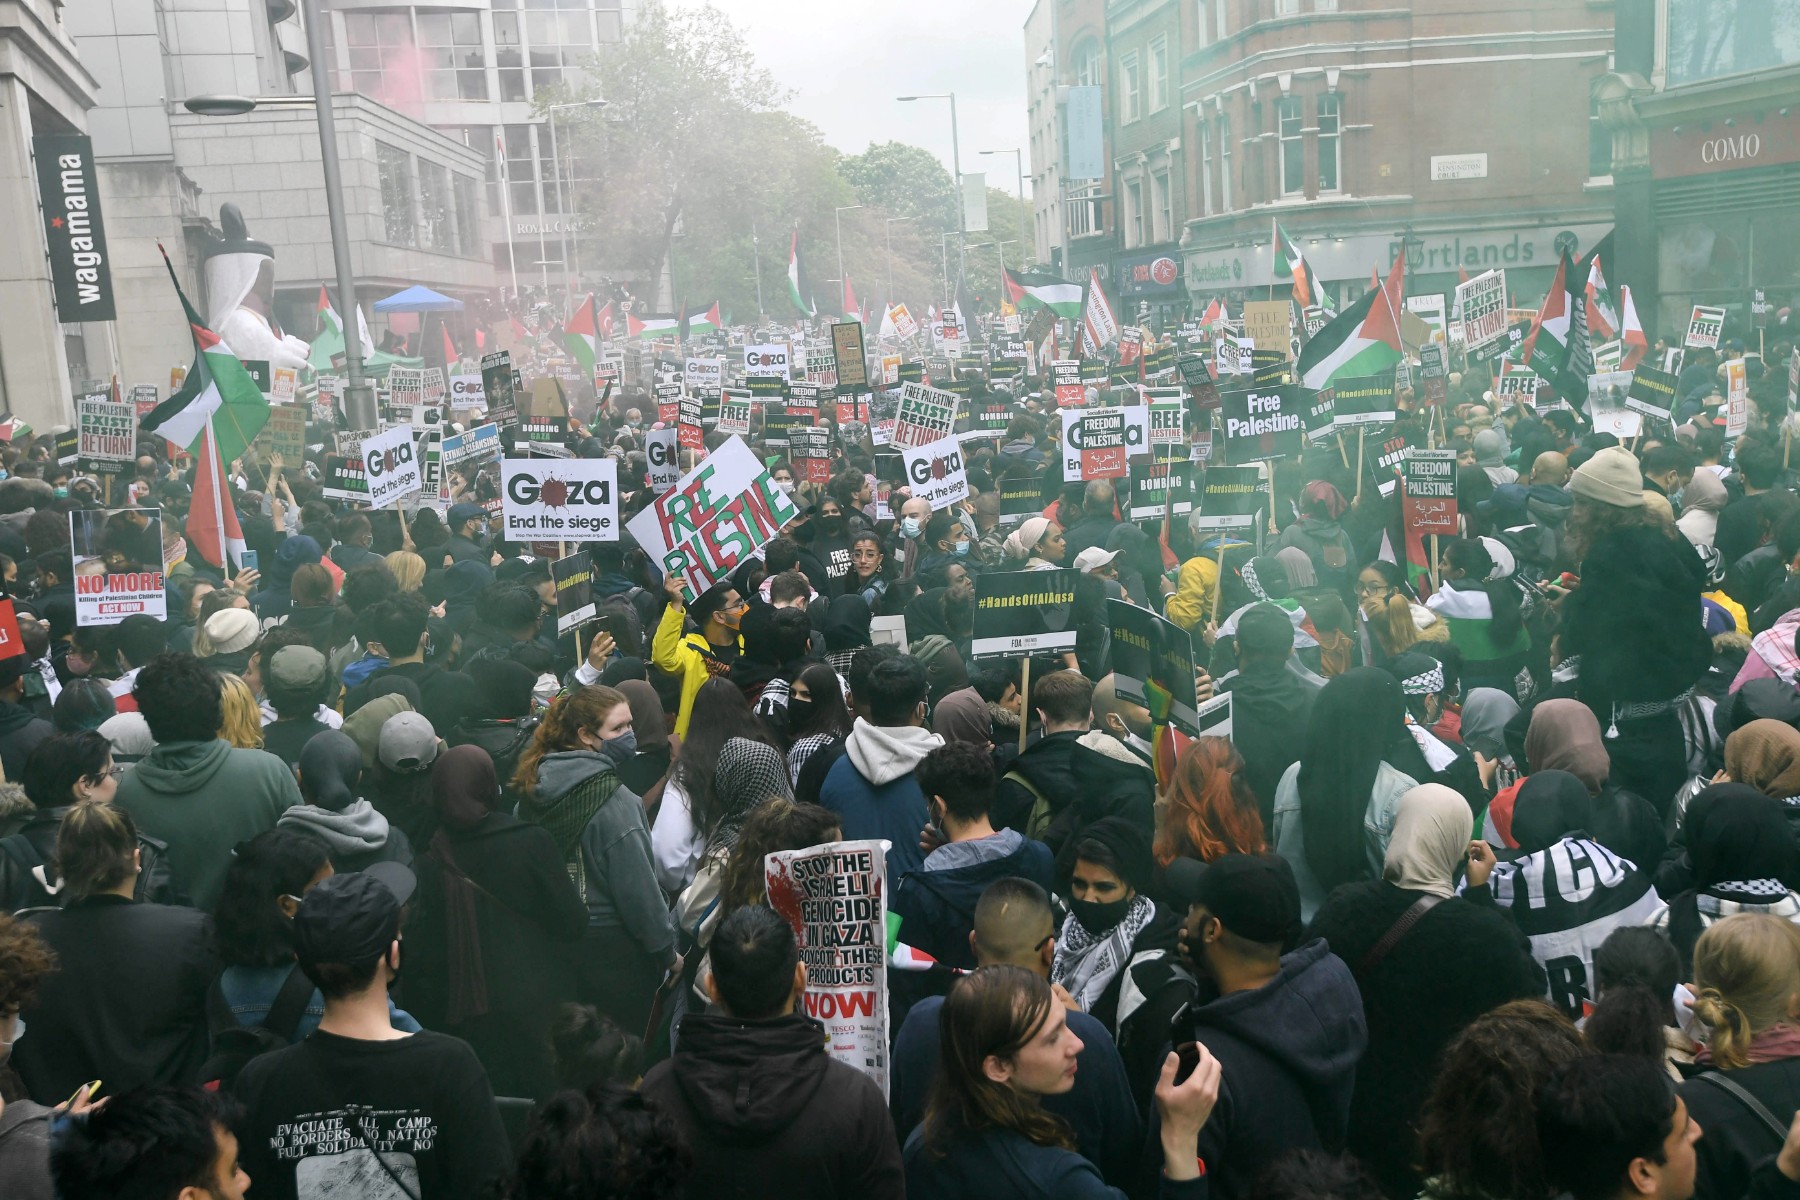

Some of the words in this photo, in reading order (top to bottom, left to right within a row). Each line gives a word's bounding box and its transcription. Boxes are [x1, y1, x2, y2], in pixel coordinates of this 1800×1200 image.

[1702, 134, 1760, 163] COMO
[1438, 164, 1480, 172] KENSINGTON
[59, 154, 102, 304] wagamama
[517, 223, 553, 234] ROYAL
[1462, 286, 1475, 300] FREE
[1476, 274, 1502, 294] PALESTINE
[1464, 286, 1502, 313] EXIST!
[1464, 300, 1504, 322] RESIST!
[1465, 309, 1504, 344] RETURN!
[1690, 322, 1720, 336] FREE
[1177, 330, 1204, 338] Palestine
[1688, 334, 1717, 342] PALESTINE
[597, 362, 614, 370] FREE
[746, 352, 786, 366] Gza
[662, 362, 676, 372] Free
[688, 362, 718, 374] Gza
[1056, 366, 1078, 374] FREEDOM
[1056, 376, 1082, 384] PALESTINE
[1500, 377, 1534, 394] FREE
[392, 391, 421, 404] RETURN!
[658, 386, 680, 395] FREEDOM
[790, 388, 816, 396] FREEDOM
[905, 384, 920, 399] FREE
[921, 388, 956, 408] PALESTINE
[1336, 388, 1392, 398] #HandsOffAlAqsa
[82, 402, 98, 414] FREE
[100, 404, 132, 417] PALESTINE
[680, 403, 700, 416] FREEDOM
[788, 398, 818, 408] PALESTINE
[902, 398, 954, 422] EXIST!
[1248, 394, 1280, 414] Free
[721, 406, 749, 420] FREE
[980, 412, 1014, 420] BOMBING
[1151, 410, 1181, 429] REE
[82, 415, 132, 428] EXIST!
[522, 424, 559, 432] BOMBING
[680, 414, 702, 428] PALESTINE
[720, 418, 748, 428] PALESTINE
[880, 419, 894, 430] STO
[900, 412, 950, 432] RESIST!
[1084, 416, 1120, 432] FREEDOM
[1227, 413, 1299, 438] Palestine
[82, 426, 132, 438] RESIST!
[340, 430, 372, 443] DIASPORA
[462, 432, 476, 444] STOP
[810, 434, 828, 444] FREEDOM
[82, 434, 132, 456] RETURN!
[1084, 432, 1123, 448] PALESTINE
[1384, 436, 1405, 454] STOP
[368, 442, 412, 477] Gza
[445, 446, 466, 460] ETHNIC
[808, 448, 828, 457] PALESTINE
[346, 460, 364, 470] STO
[910, 450, 961, 485] Gza
[1410, 462, 1450, 475] FREEDOM
[335, 468, 367, 480] BOMB
[652, 474, 667, 484] End
[668, 474, 678, 483] the
[372, 486, 386, 498] End
[387, 480, 398, 492] the
[398, 472, 416, 485] siege
[508, 472, 610, 505] Gza
[935, 487, 948, 500] the
[948, 480, 964, 494] siege
[1140, 476, 1182, 490] BOMBNG
[1205, 484, 1254, 494] #HandsOffAlAqsa
[1408, 482, 1454, 496] PALESTINE
[654, 464, 730, 551] FREE
[1416, 500, 1446, 514] الحرية
[509, 515, 536, 528] End
[540, 515, 564, 528] the
[568, 515, 610, 532] siege
[1412, 514, 1450, 526] لفلسطين
[663, 471, 795, 604] PALESTINE
[830, 549, 850, 564] FREE
[826, 562, 852, 578] PALES
[77, 575, 104, 594] NO
[108, 572, 163, 592] MORE
[978, 592, 1074, 609] #HandsOffAlAqsa
[102, 602, 120, 614] ACT
[120, 602, 142, 613] NOW
[793, 856, 833, 880] STOP
[833, 852, 871, 874] THE
[801, 874, 869, 898] ISRAELI
[801, 898, 880, 923] GENOCIDE
[808, 924, 818, 946] IN
[822, 922, 874, 946] GAZA
[800, 948, 836, 966] BOYCOTT
[840, 948, 882, 965] THESE
[808, 966, 873, 984] PRODUCTS
[278, 1118, 344, 1136] EVACUATE
[358, 1116, 380, 1130] ALL
[270, 1136, 285, 1148] NO
[292, 1128, 350, 1146] BORDERS
[364, 1129, 379, 1140] NO
[278, 1146, 308, 1158] FULL
[317, 1136, 396, 1154] SOLIDAITY
